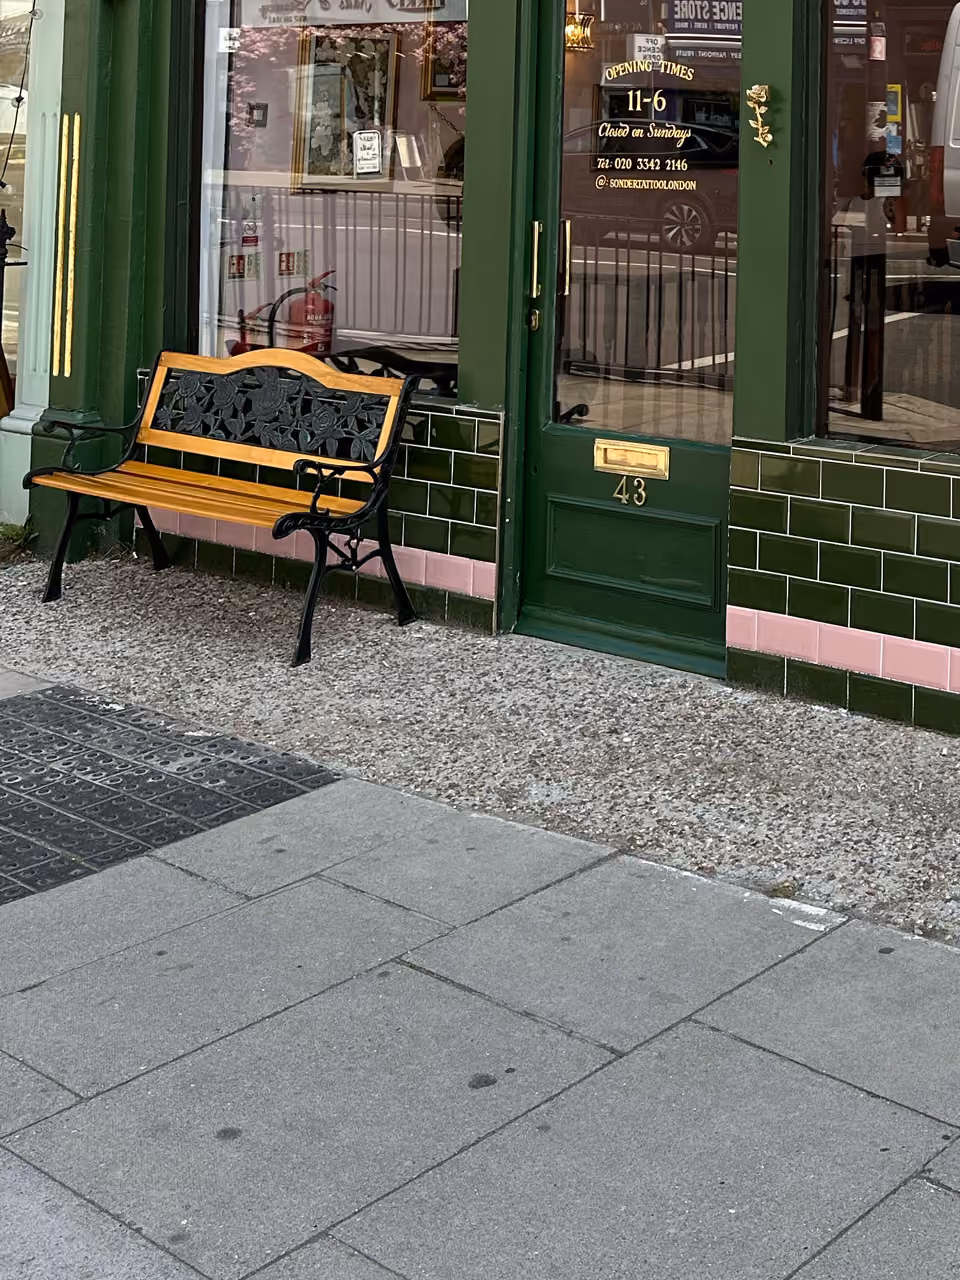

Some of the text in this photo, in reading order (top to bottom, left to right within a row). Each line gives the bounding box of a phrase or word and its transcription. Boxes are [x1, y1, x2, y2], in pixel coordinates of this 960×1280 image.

[605, 60, 653, 80] OPENING
[660, 60, 695, 81] TIMES
[627, 89, 667, 112] 11-6
[598, 122, 692, 148] Closed on Sundays
[597, 158, 689, 171] Tel: 020 3342 2146
[612, 476, 646, 507] 43
